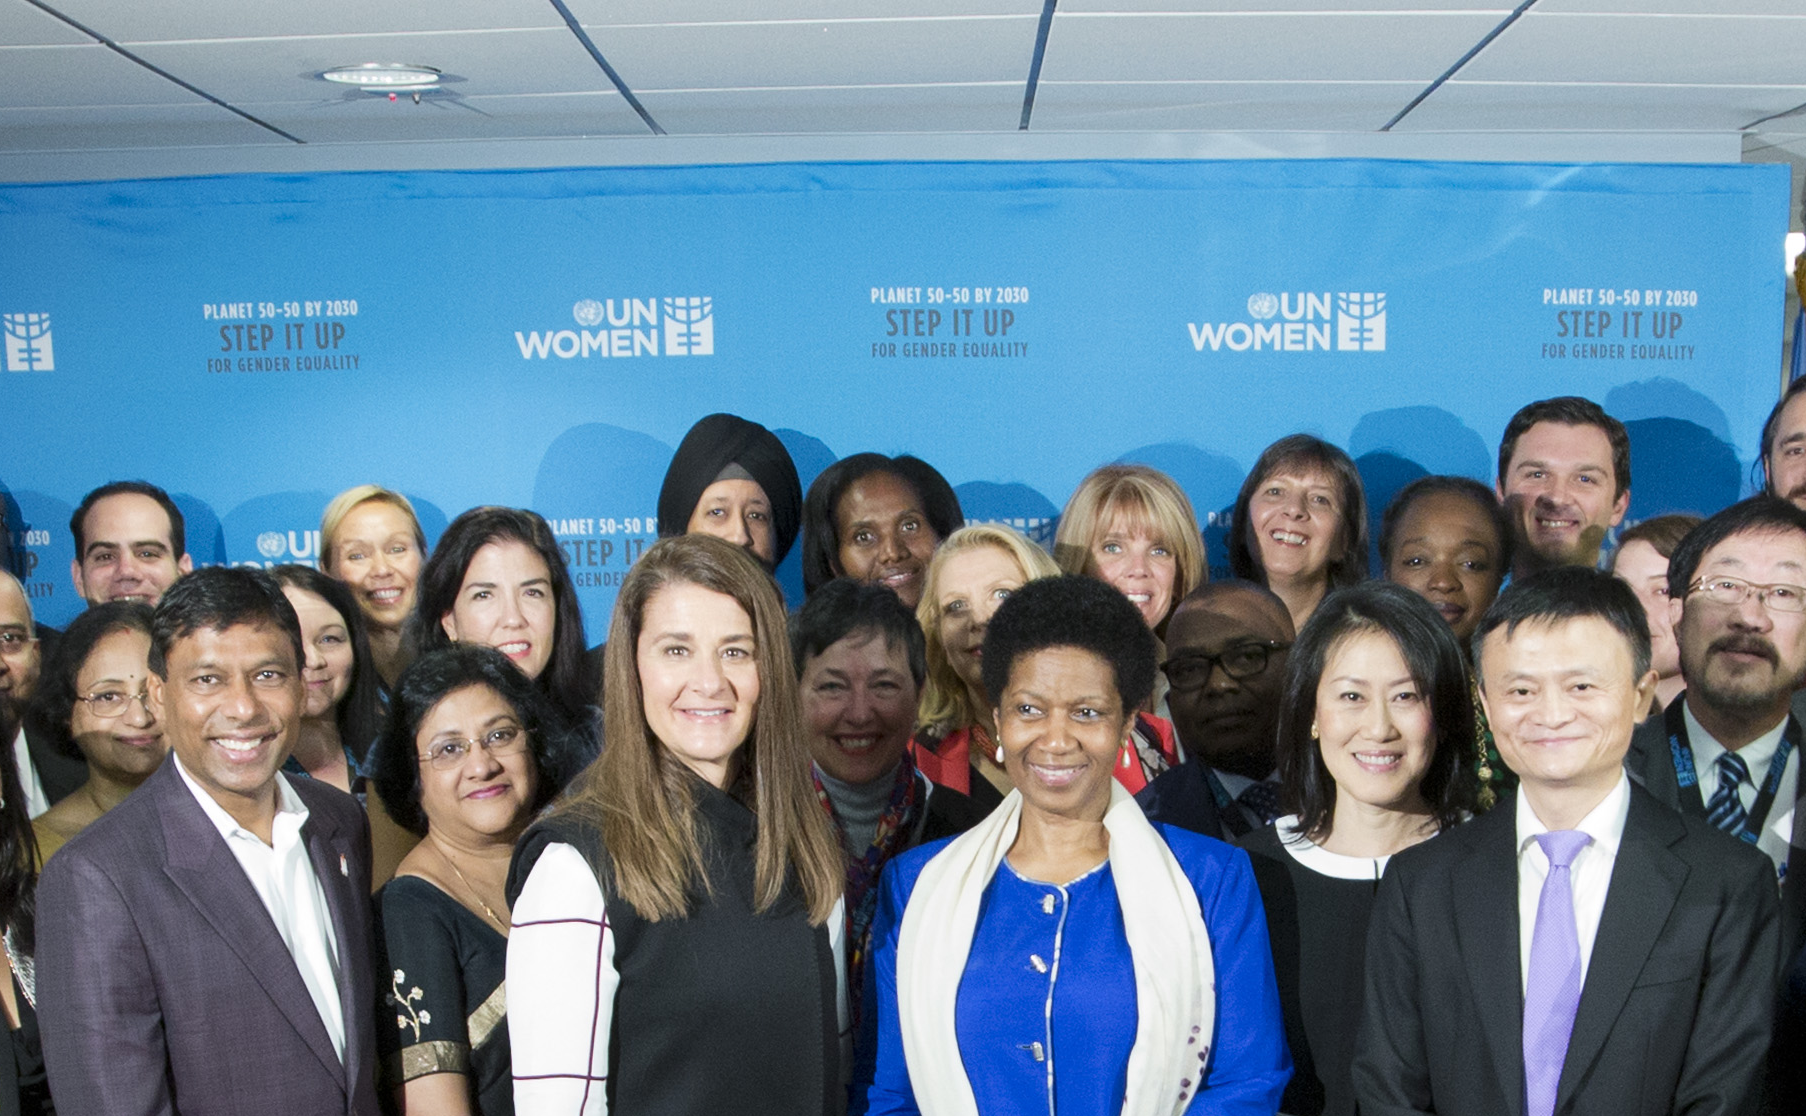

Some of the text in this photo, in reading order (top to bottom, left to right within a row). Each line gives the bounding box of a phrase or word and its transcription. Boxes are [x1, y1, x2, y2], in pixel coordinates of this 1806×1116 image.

[871, 287, 1029, 304] PLANET 50-50 BY 2030
[1280, 292, 1331, 321] UN
[1543, 288, 1698, 307] PLANET 50-50 BY 2030
[203, 299, 358, 320] PLANET 50-50 BY 2030
[606, 298, 658, 327] UN
[886, 309, 1015, 336] STEP IT UP
[1557, 310, 1683, 339] STEP IT UP
[220, 322, 345, 352] STEP IT UP
[514, 328, 658, 360] WOMEN
[1187, 322, 1331, 351] WOMEN
[872, 342, 1028, 358] FOR GENDER EQUALITY
[1542, 343, 1695, 360] FOR GENDER EQUALITY
[207, 354, 359, 373] FOR GENDER EQUALITY
[599, 518, 642, 535] 50-50
